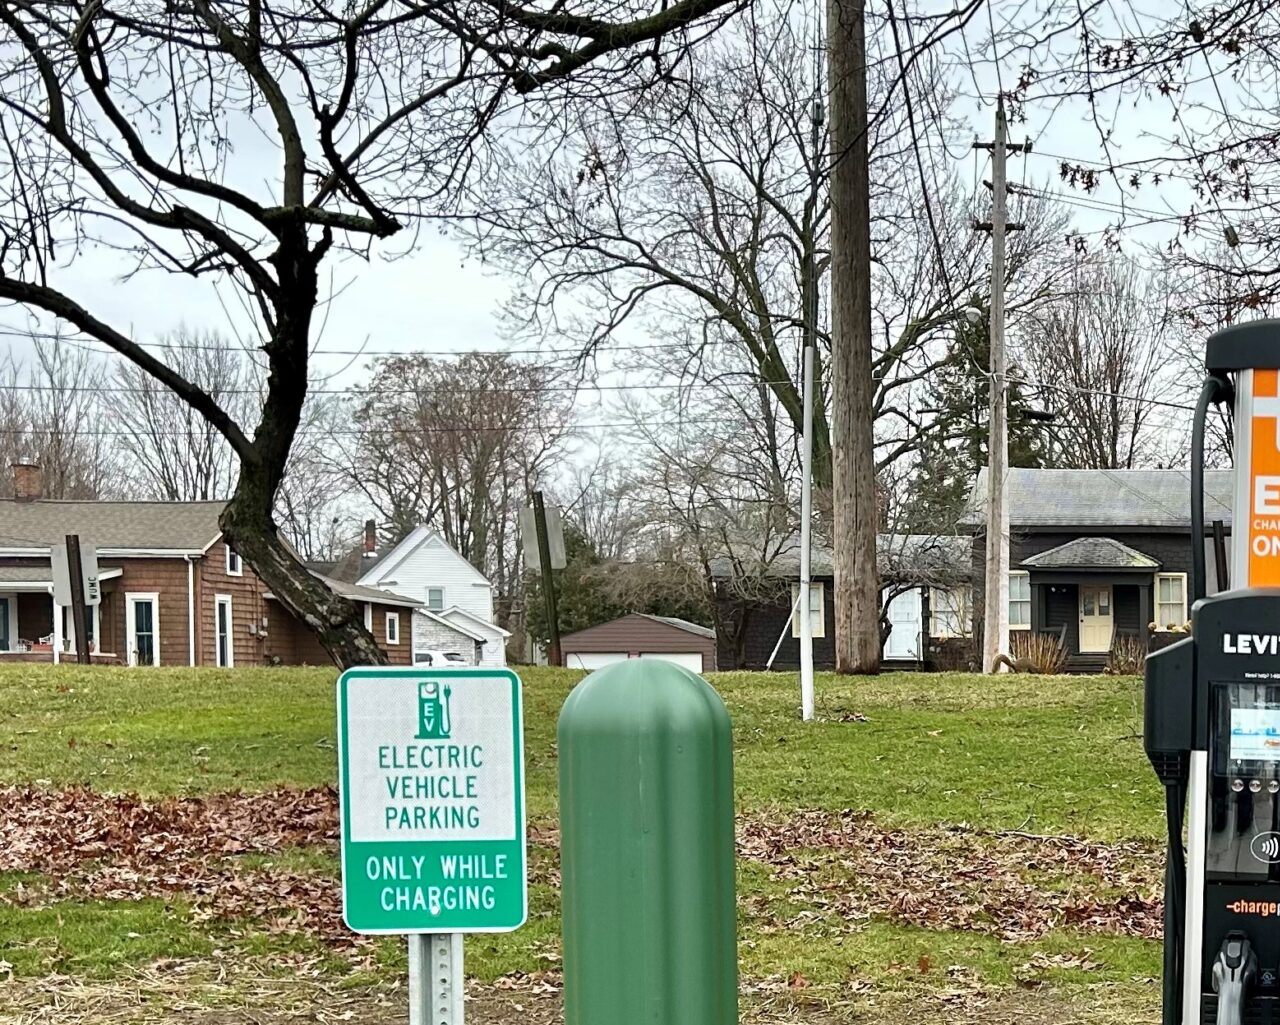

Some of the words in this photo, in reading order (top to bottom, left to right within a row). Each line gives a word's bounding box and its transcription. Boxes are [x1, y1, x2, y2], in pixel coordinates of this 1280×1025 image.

[88, 576, 98, 600] WUMC
[379, 745, 483, 769] ELECTRIC
[386, 775, 478, 799] VEHICLE
[385, 806, 480, 829] PARKING
[366, 856, 426, 881] ONLY
[440, 854, 508, 880] WHILE
[380, 885, 496, 911] CHARGING
